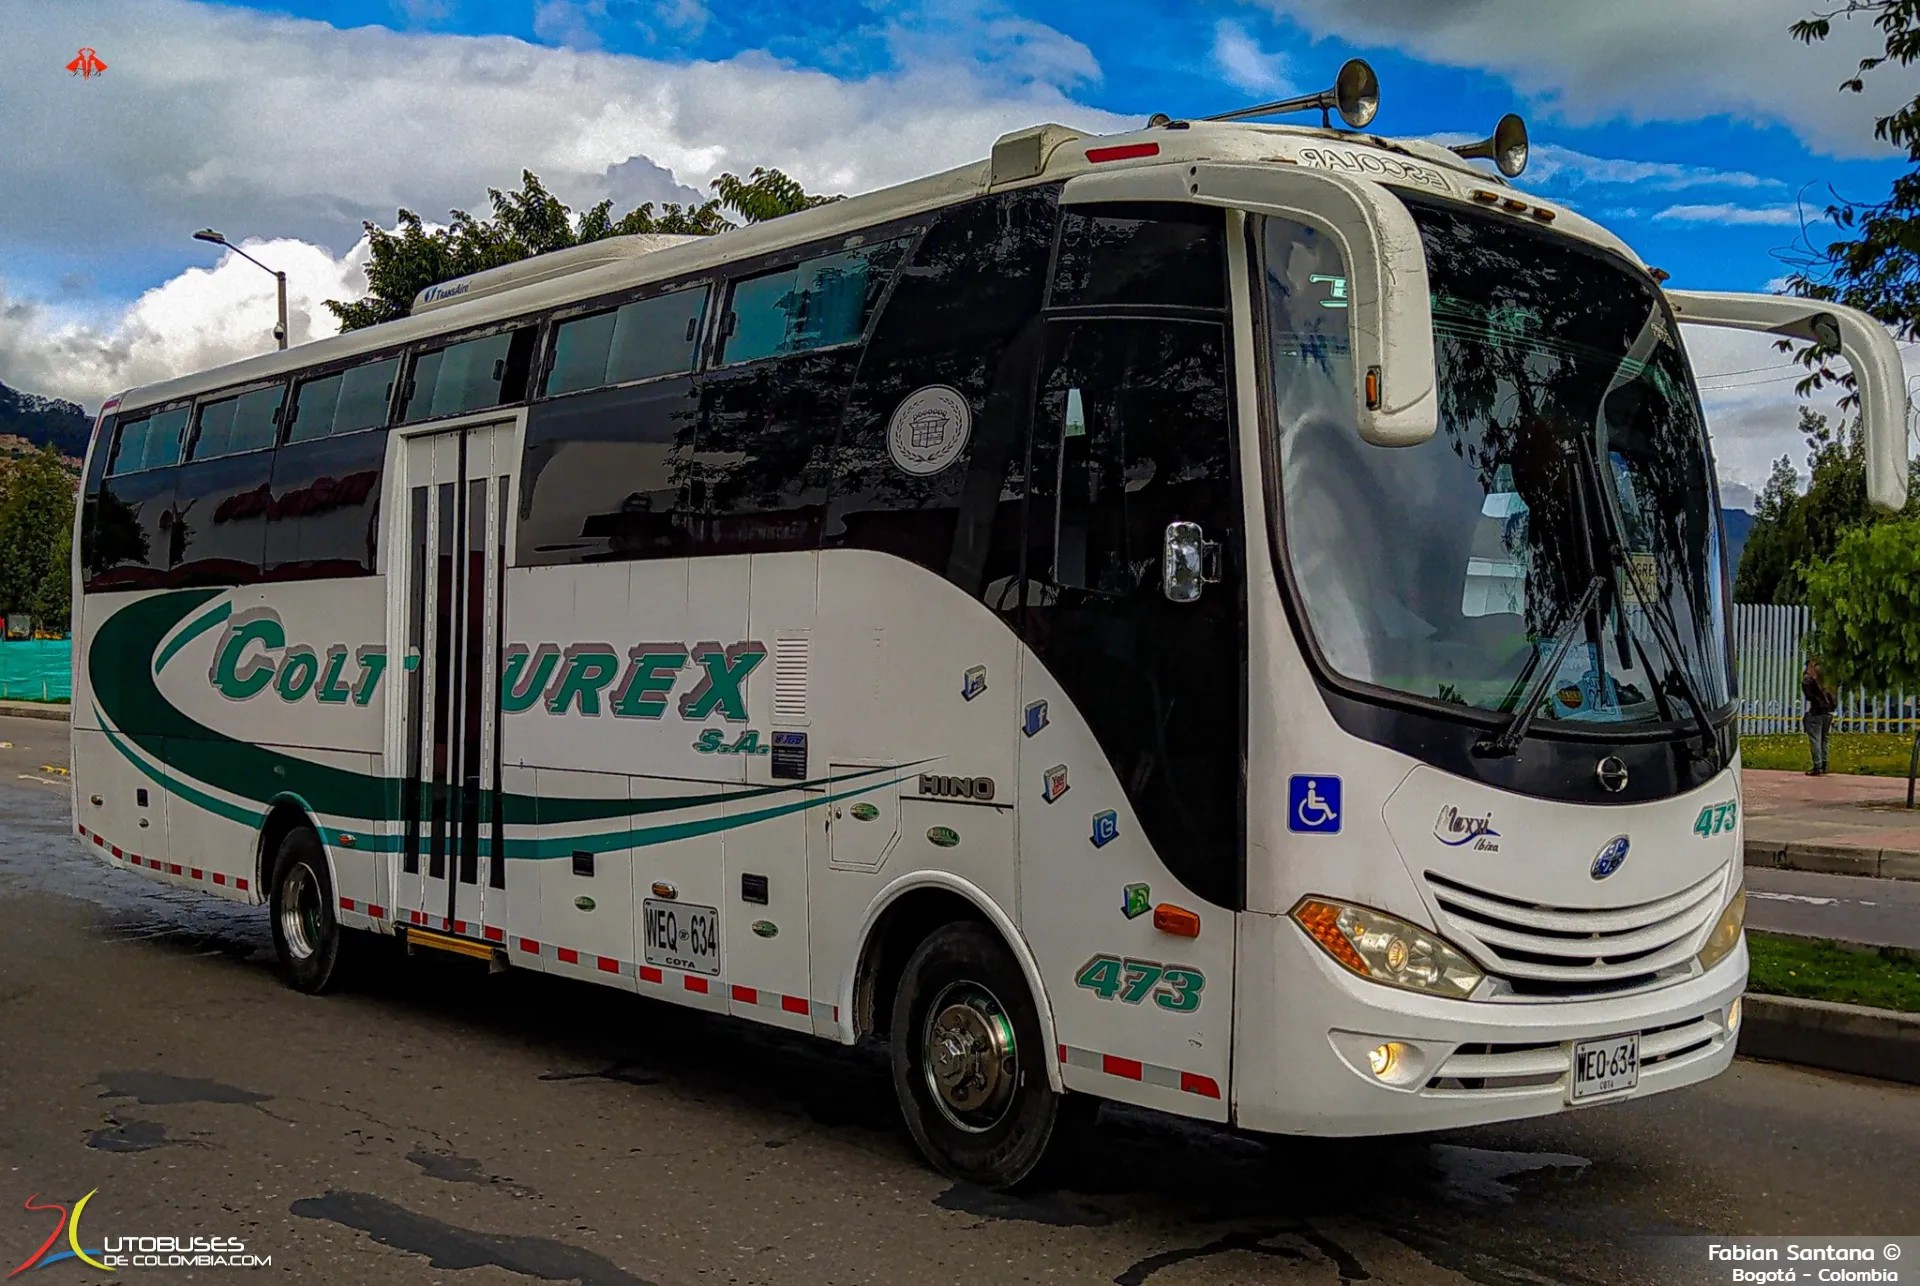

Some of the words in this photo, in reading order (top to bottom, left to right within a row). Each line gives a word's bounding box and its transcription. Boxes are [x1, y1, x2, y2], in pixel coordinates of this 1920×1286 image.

[919, 773, 995, 800] HINO
[1692, 799, 1737, 839] 473
[1473, 837, 1499, 852] Ibiza
[645, 907, 677, 953] WEQ
[691, 914, 716, 957] 634
[665, 957, 695, 968] COTA
[1074, 953, 1206, 1014] 473
